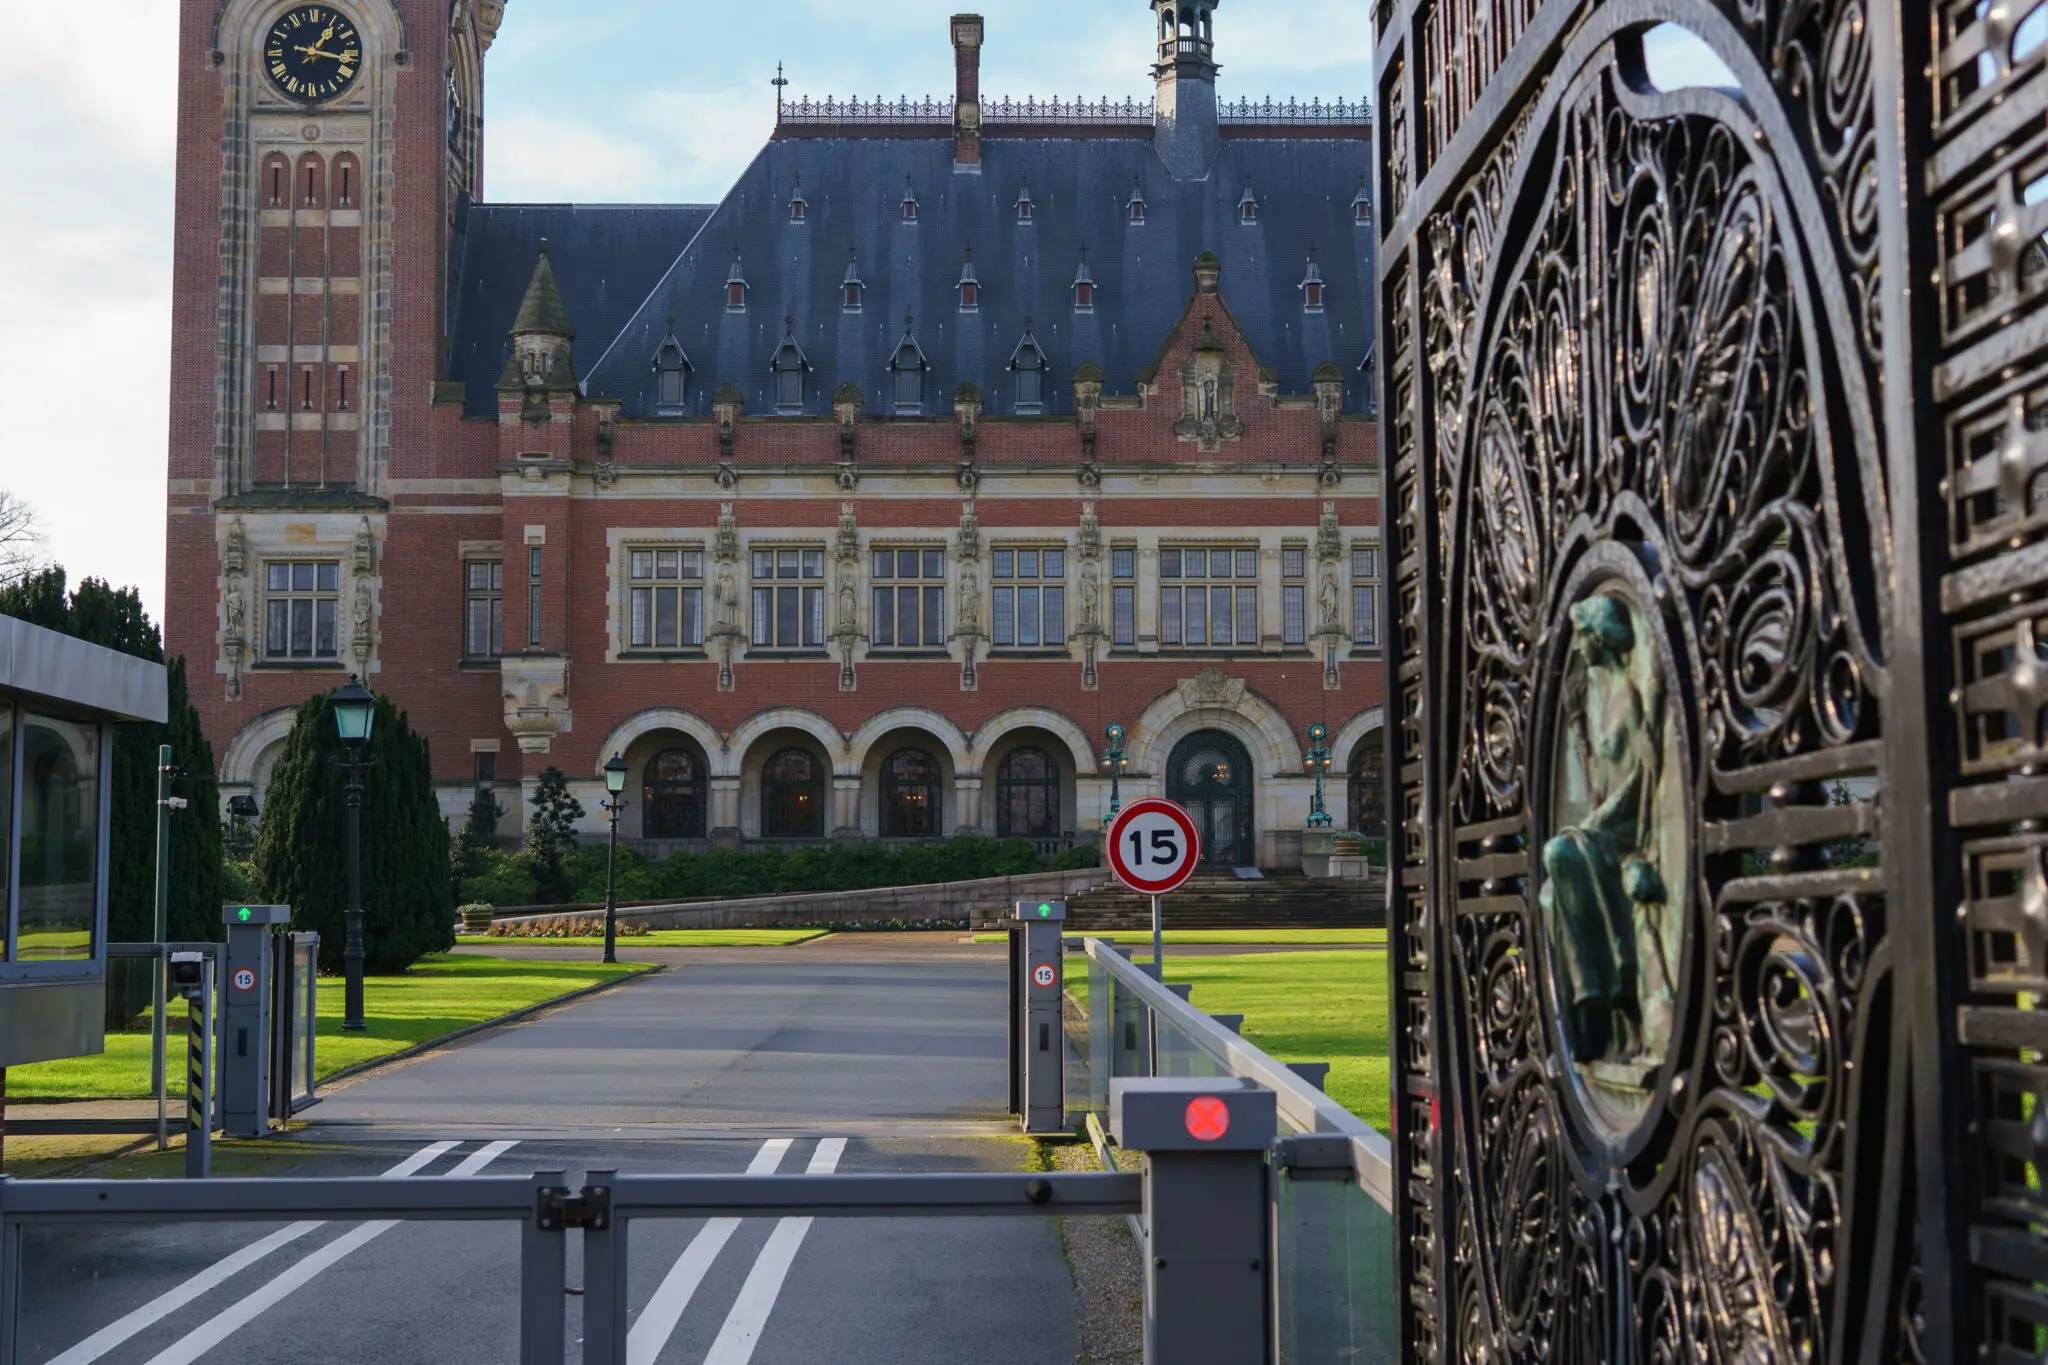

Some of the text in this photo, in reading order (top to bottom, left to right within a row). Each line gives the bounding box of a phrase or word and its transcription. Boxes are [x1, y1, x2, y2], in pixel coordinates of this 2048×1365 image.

[309, 9, 319, 23] XII
[1129, 829, 1179, 866] 15
[237, 974, 252, 985] 15
[1037, 970, 1051, 981] 15
